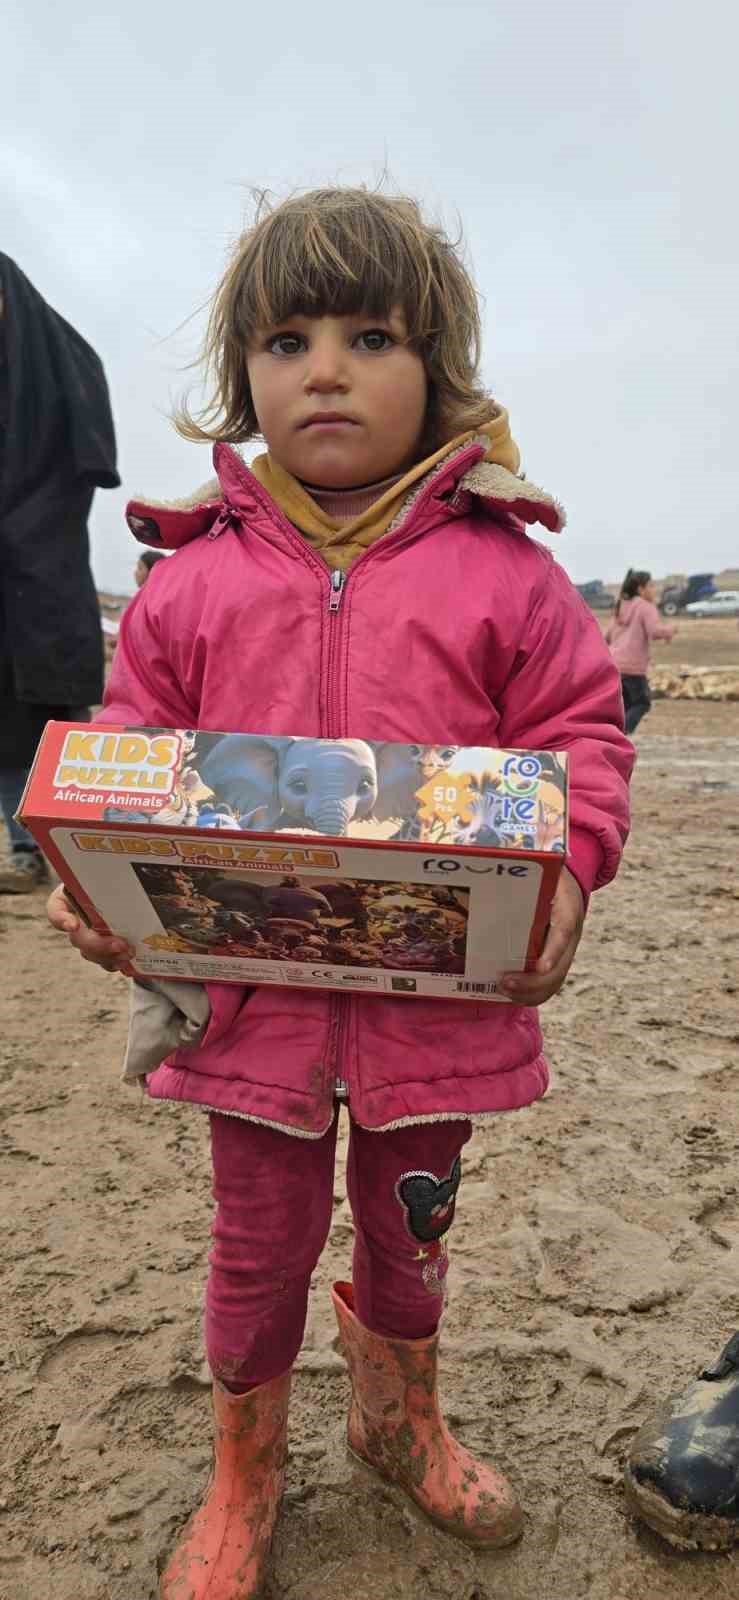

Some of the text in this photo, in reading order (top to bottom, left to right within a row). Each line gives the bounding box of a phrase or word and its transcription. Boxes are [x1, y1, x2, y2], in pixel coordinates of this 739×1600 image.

[64, 734, 177, 766] KIDS
[58, 765, 171, 790] PUZZLE
[54, 789, 163, 808] African Animals
[432, 786, 457, 803] 50
[502, 823, 537, 833] GAMES
[78, 834, 337, 868] KIDS PUZZLE
[183, 856, 294, 872] African Animals
